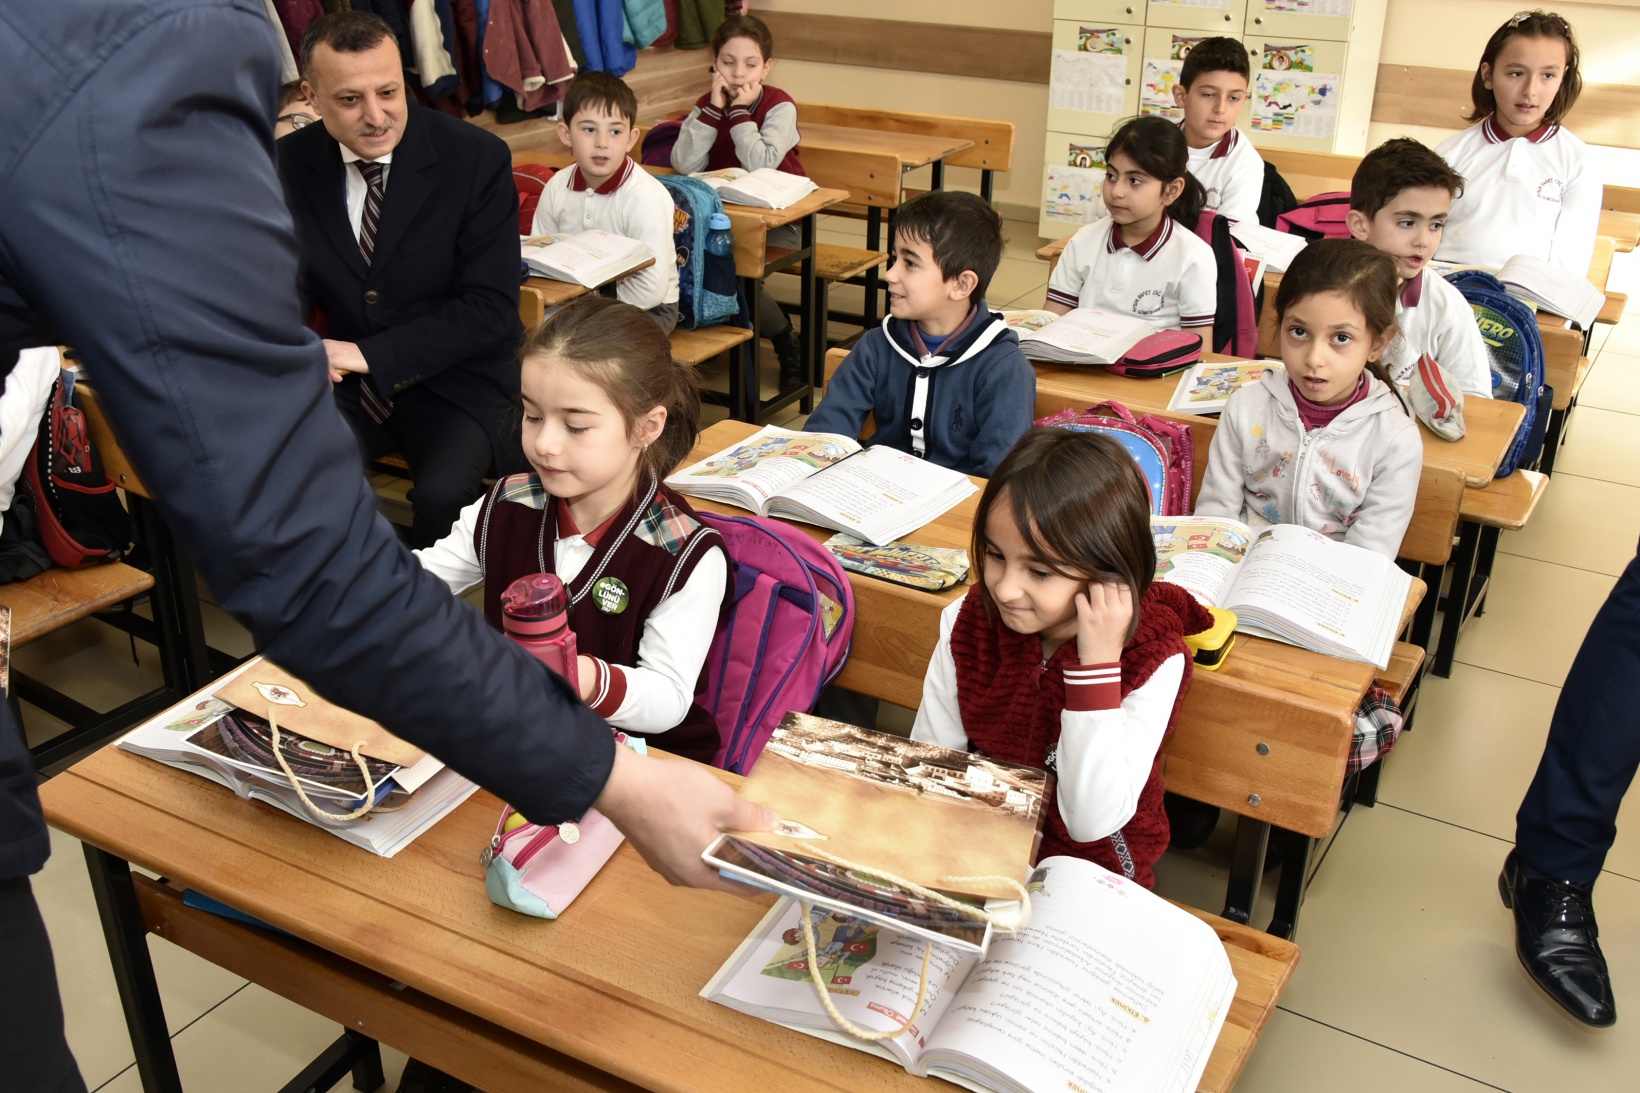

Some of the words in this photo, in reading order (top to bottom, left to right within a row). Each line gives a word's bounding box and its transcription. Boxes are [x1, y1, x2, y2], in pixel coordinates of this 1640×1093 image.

[1330, 456, 1360, 492] Lovely
[600, 582, 625, 596] #GÖN-
[598, 590, 620, 604] LÜNÜ
[602, 598, 618, 611] VER
[1027, 941, 1044, 950] Hoca
[1047, 948, 1079, 968] Nasreddin
[1004, 961, 1031, 971] görünce
[928, 980, 940, 994] Türk
[902, 994, 927, 1016] Mnacık
[999, 994, 1031, 1007] görüyor?
[1073, 993, 1091, 1006] tekrar
[1114, 987, 1148, 1011] Defterinize
[871, 1003, 893, 1016] Okuma
[979, 1008, 1002, 1019] uykusu
[990, 1001, 1022, 1015] görüyor?
[1111, 997, 1139, 1018] Etkinlik
[1044, 1013, 1067, 1031] bakınca
[1056, 1007, 1081, 1027] kuyudan
[1005, 1018, 1027, 1031] zaman
[1044, 1026, 1067, 1044] bakınca
[1070, 1029, 1092, 1047] kuyuya
[1069, 1056, 1102, 1080] Nasreddin
